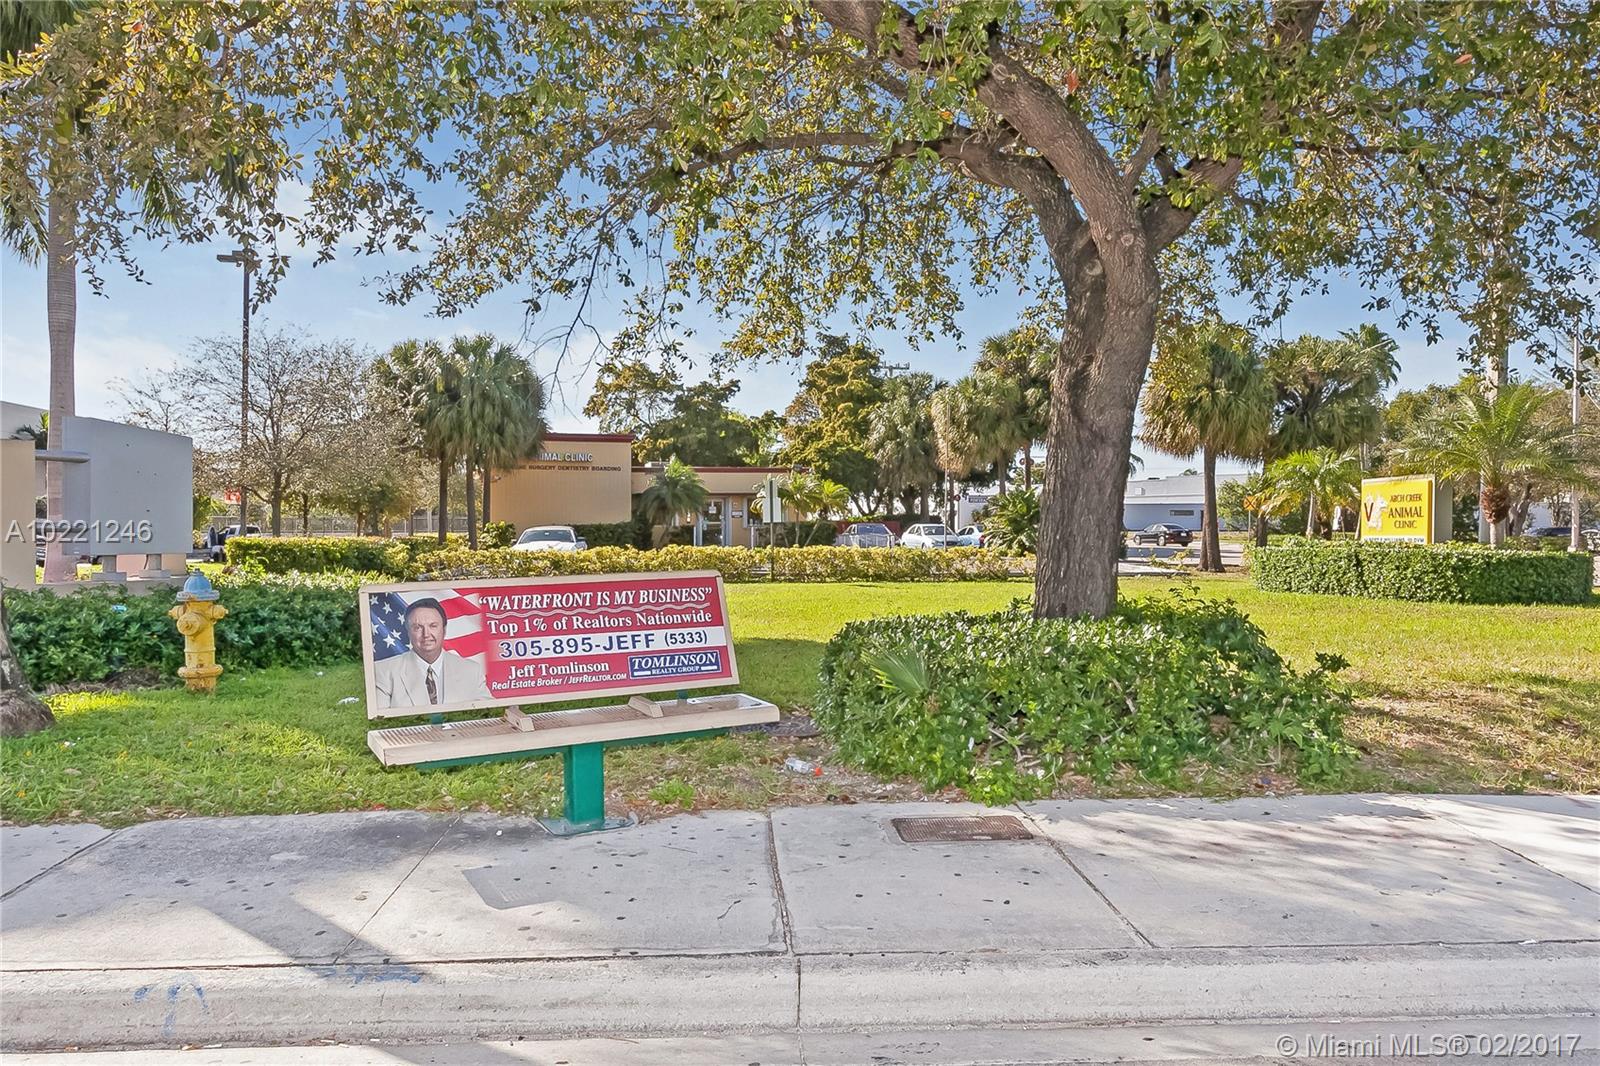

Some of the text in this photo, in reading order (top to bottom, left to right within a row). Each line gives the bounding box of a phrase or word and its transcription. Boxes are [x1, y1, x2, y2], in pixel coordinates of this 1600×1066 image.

[564, 453, 593, 462] CLINIC
[1390, 493, 1423, 502] ARCH CREEK
[1388, 506, 1424, 518] ANIMAL
[1394, 520, 1418, 529] CLINIC
[596, 591, 611, 606] IS
[614, 590, 635, 605] MY
[487, 610, 712, 637] Top 1% of Realtors Nationwide
[500, 630, 707, 658] 305-895-JEFF (5333)
[632, 653, 716, 670] TOMLINSON
[508, 661, 609, 680] Jeff Tomlinson
[651, 665, 700, 675] REALTY GROUP
[491, 681, 510, 690] Real
[510, 679, 536, 689] Estate
[536, 677, 563, 687] Broker
